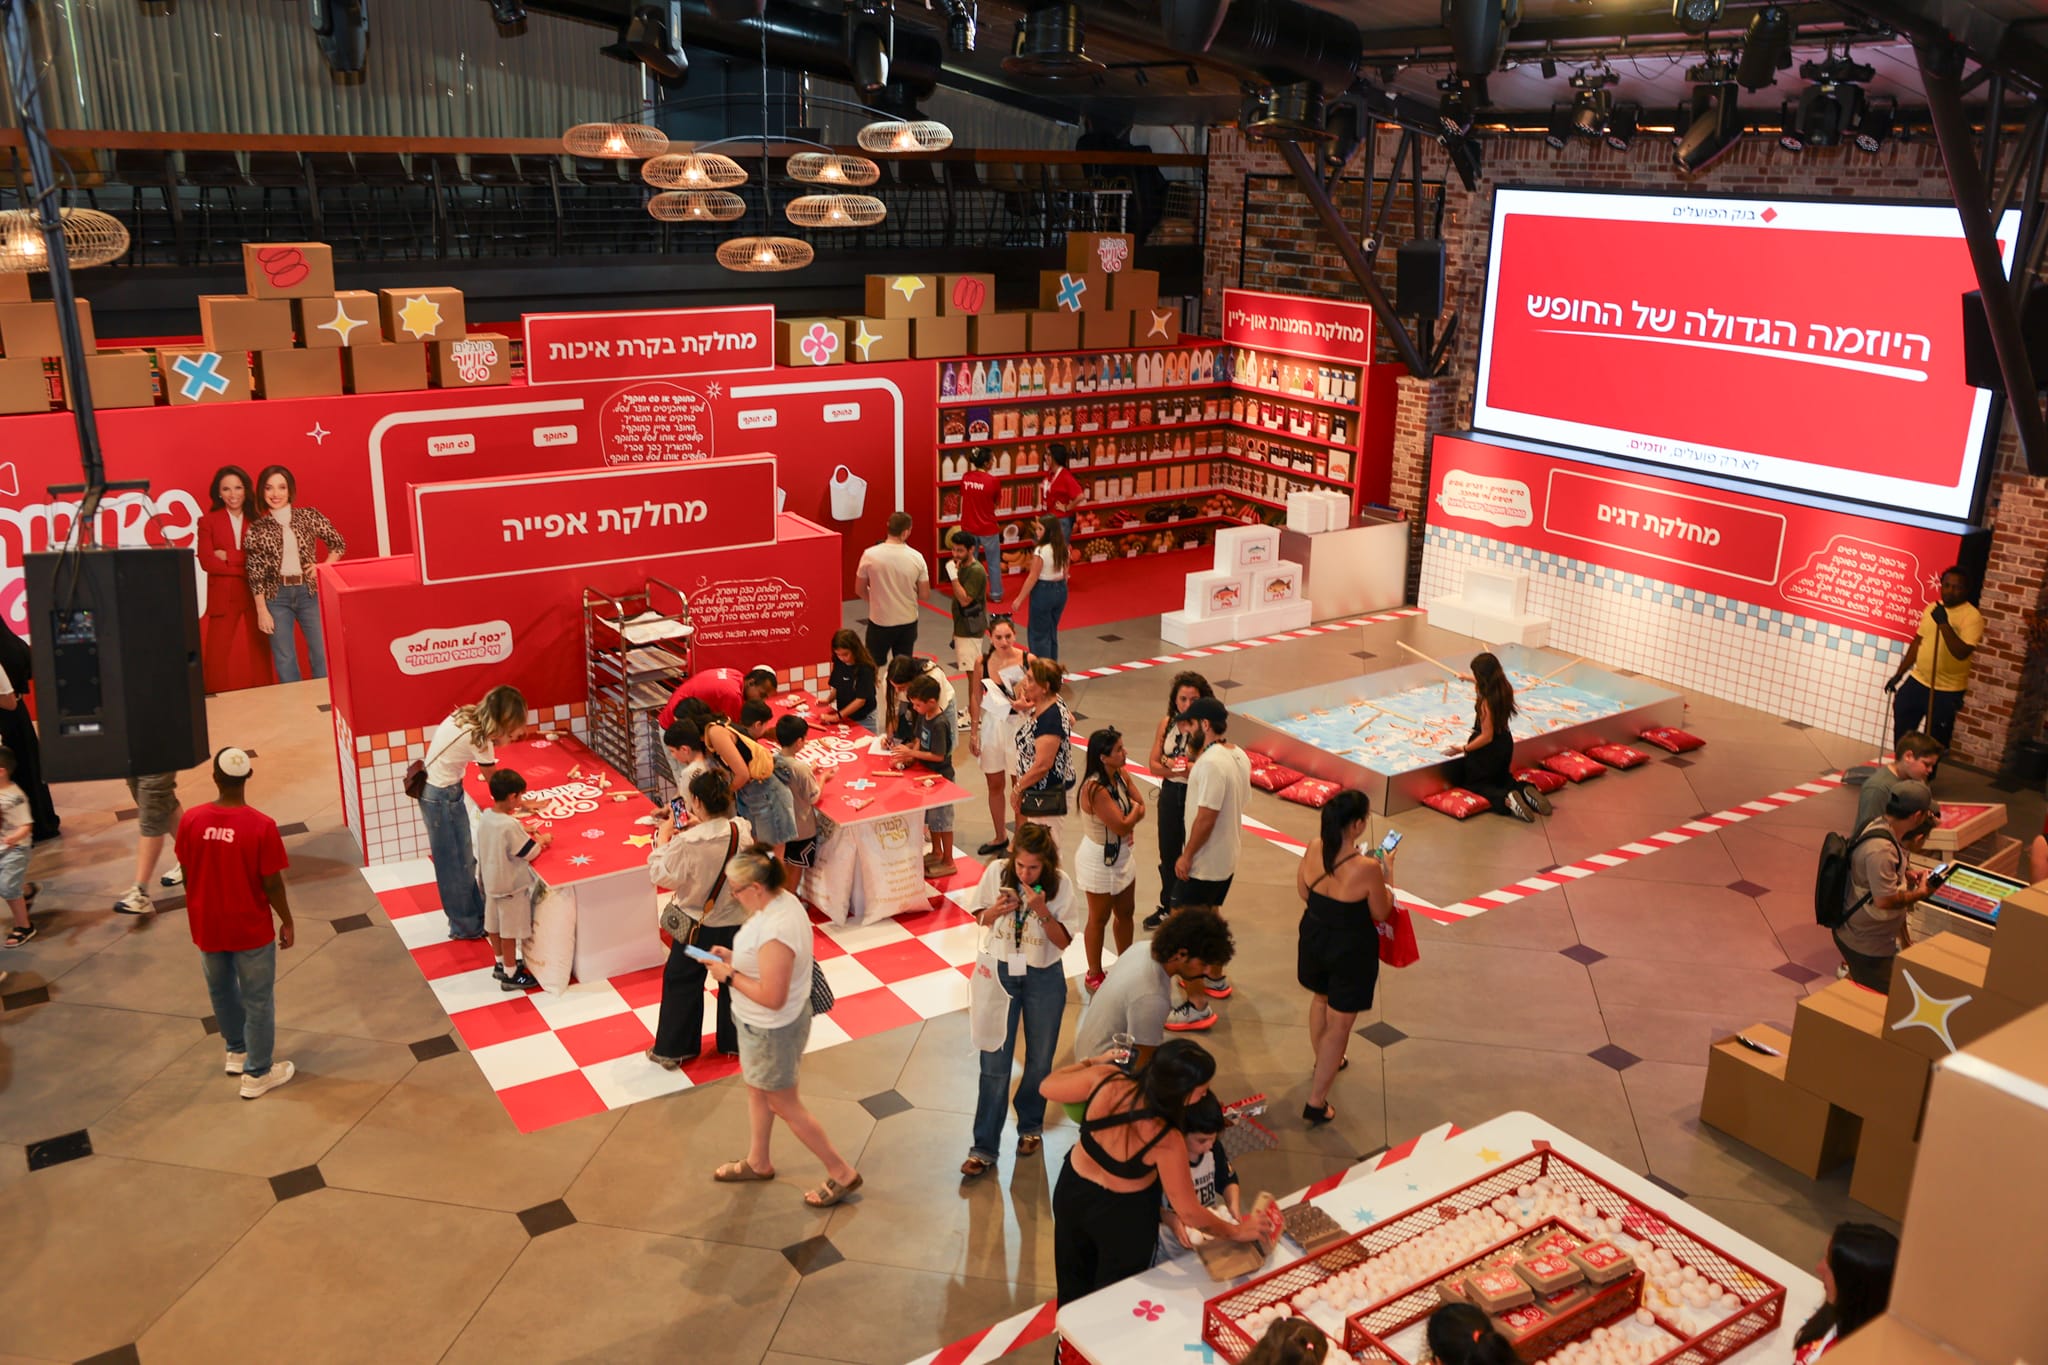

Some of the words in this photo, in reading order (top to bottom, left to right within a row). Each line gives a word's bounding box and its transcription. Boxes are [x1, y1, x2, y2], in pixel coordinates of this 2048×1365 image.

[1673, 206, 1728, 219] הפועלים
[1730, 209, 1755, 222] בנק
[1527, 294, 1623, 327] החופש
[1632, 300, 1677, 332] של
[1228, 309, 1266, 331] און-ליין
[1270, 316, 1312, 335] הזמנות
[1315, 322, 1364, 343] מחלקת
[1684, 308, 1796, 347] הגדולה
[455, 341, 492, 352] פועלים
[617, 337, 676, 359] בקרת
[682, 332, 757, 356] מחלקת
[1807, 323, 1931, 362] היוזמה
[549, 341, 610, 360] איכות
[462, 367, 488, 381] סיטי
[623, 395, 646, 404] תוקף?
[672, 396, 696, 404] בתוקף
[653, 405, 687, 414] שמכניסים
[690, 402, 705, 413] לפני
[831, 408, 852, 418] בתוקף
[670, 415, 696, 424] בודקים
[743, 416, 760, 425] תוקף
[621, 424, 651, 433] בתוקף?
[654, 425, 671, 433] עדיין
[542, 432, 569, 442] בתוקף
[642, 432, 657, 441] לסל
[434, 441, 455, 452] תוקף
[457, 440, 470, 449] פג
[665, 443, 692, 452] התאריך
[646, 451, 661, 460] לסל
[1720, 455, 1738, 467] רק
[1741, 458, 1759, 470] לא
[598, 500, 708, 534] מחלקת
[1597, 504, 1640, 528] דגים
[502, 513, 588, 543] אפייה
[1643, 513, 1721, 546] מחלקת
[1860, 562, 1879, 573] לכם
[432, 638, 459, 650] תופח
[462, 632, 477, 645] לא
[408, 638, 430, 653] לבד
[487, 644, 501, 656] מי
[451, 646, 486, 661] שעובד
[879, 818, 902, 831] קמח
